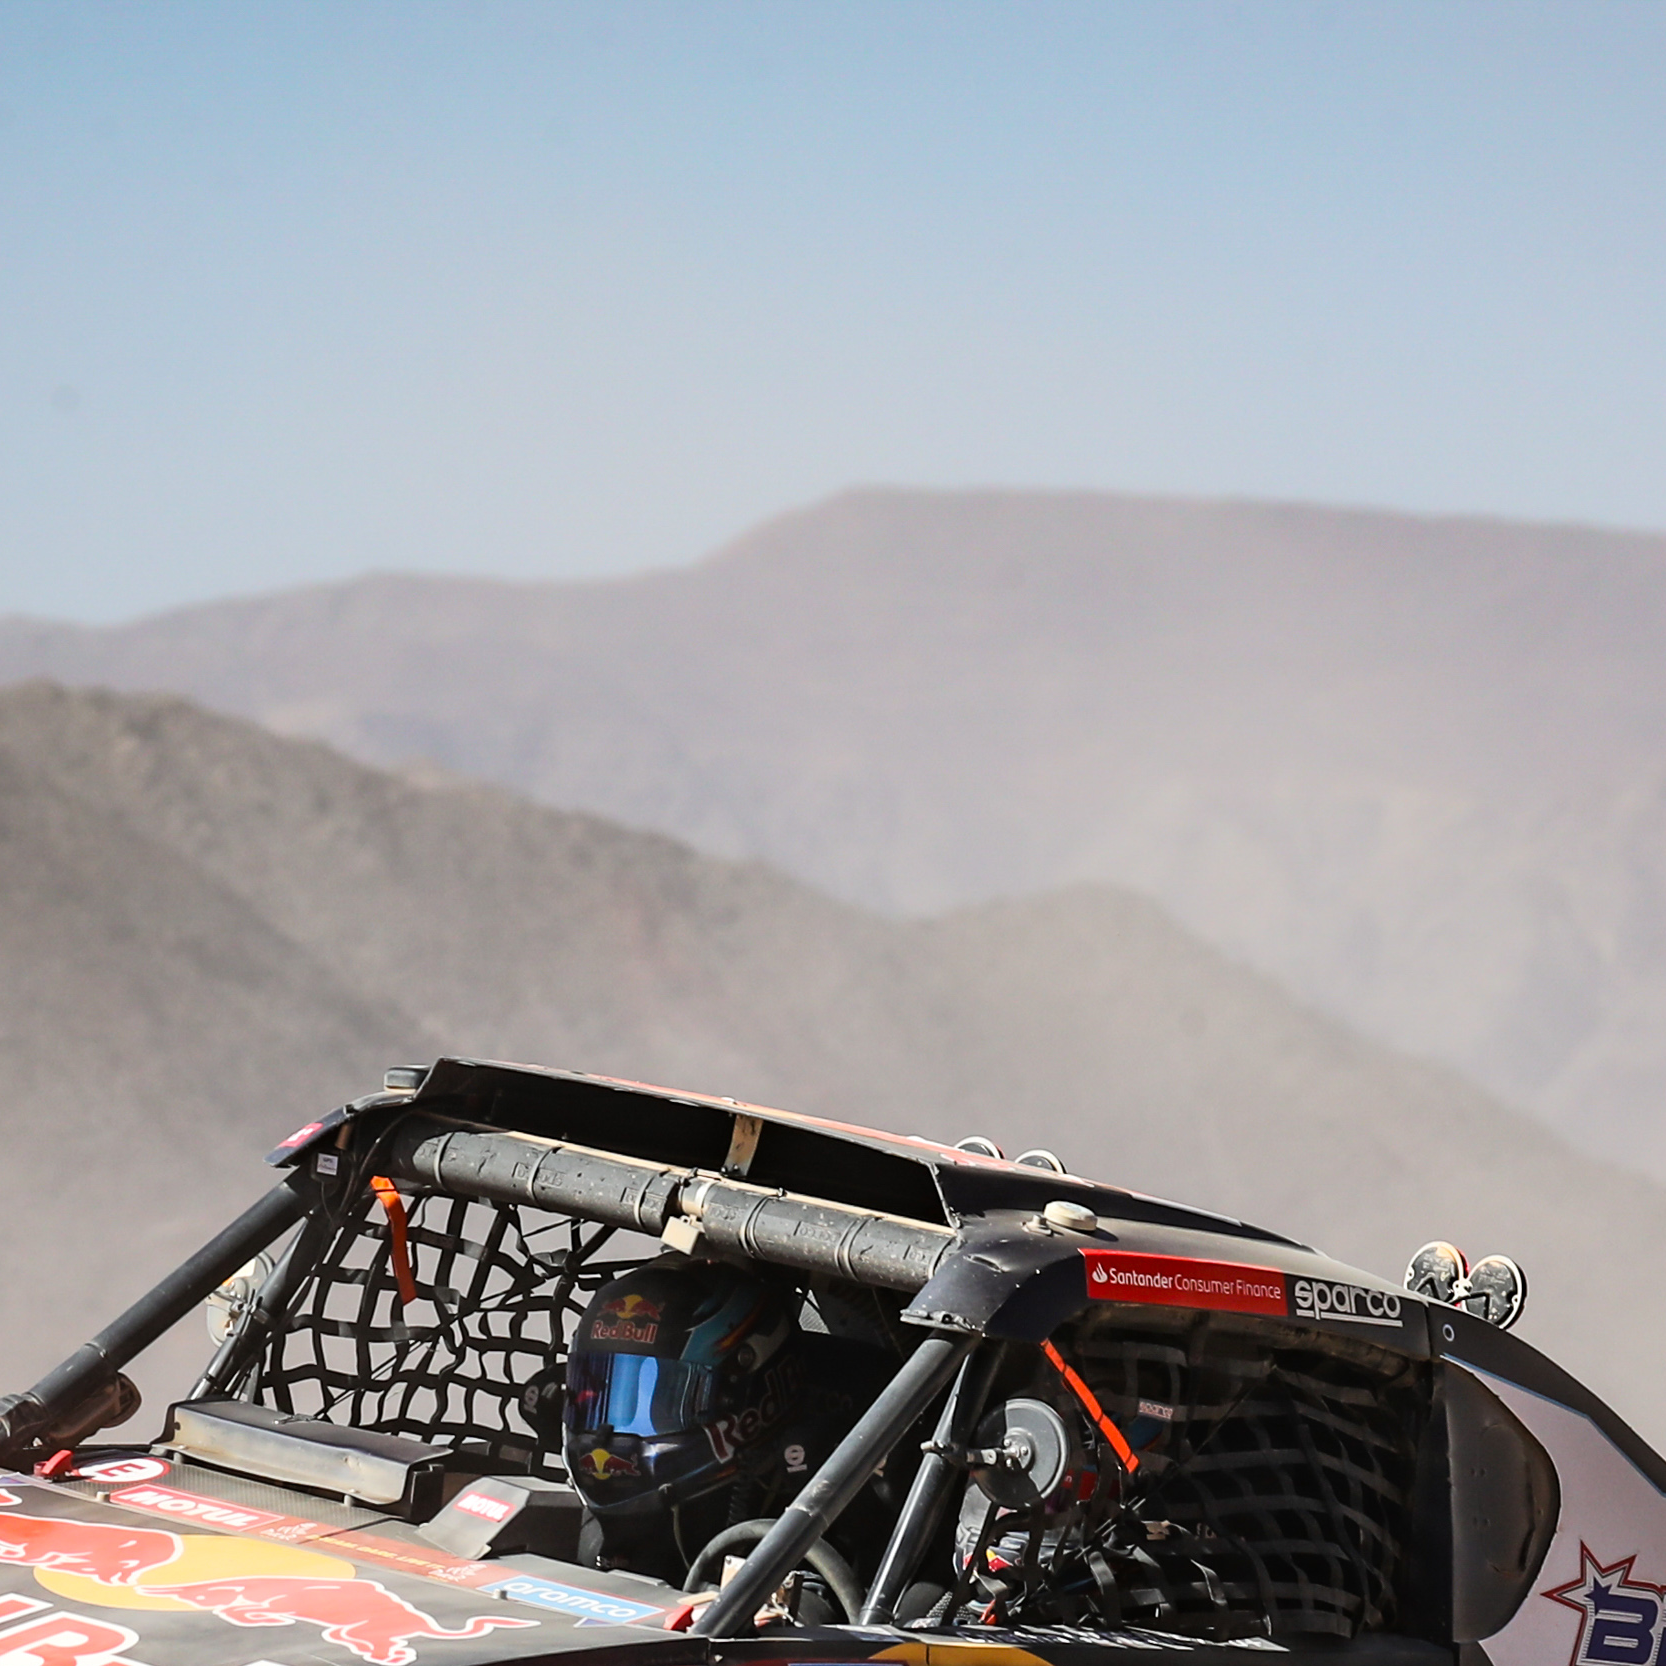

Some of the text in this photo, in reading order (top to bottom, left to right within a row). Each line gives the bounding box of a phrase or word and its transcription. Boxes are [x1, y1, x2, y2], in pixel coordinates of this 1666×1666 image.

[1108, 1267, 1282, 1299] Santander Consumer Finance
[1294, 1279, 1401, 1319] sparco
[590, 1320, 659, 1344] Red Bull
[118, 1489, 260, 1527] MOTUL
[456, 1493, 509, 1521] MOTUL
[502, 1581, 637, 1619] aramco
